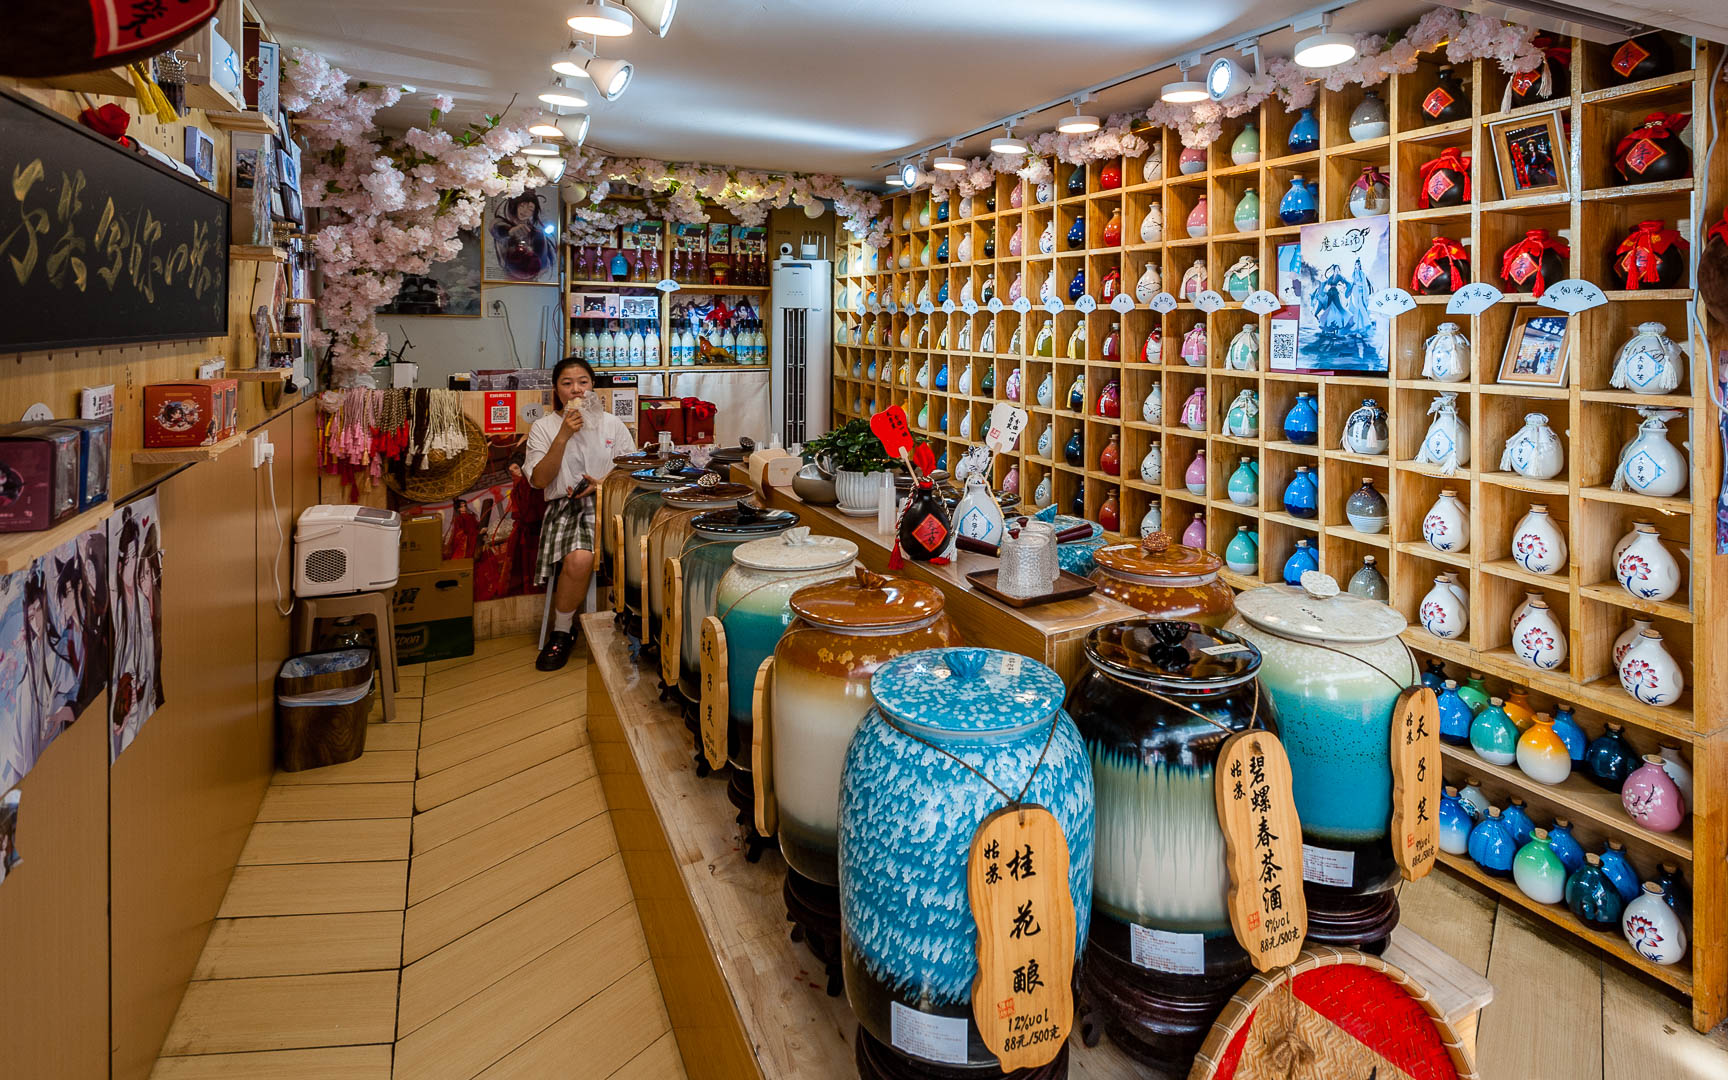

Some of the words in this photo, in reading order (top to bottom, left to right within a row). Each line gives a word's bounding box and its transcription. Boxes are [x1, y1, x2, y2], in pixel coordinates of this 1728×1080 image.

[924, 520, 940, 547] 天子笑
[1406, 711, 1415, 745] 姑苏
[1230, 759, 1247, 801] 姑苏
[1415, 714, 1429, 824] 天子笑
[1248, 755, 1283, 915] 碧螺春茶酒
[983, 839, 1003, 885] 姑苏
[1006, 844, 1044, 995] 桂花酿
[1003, 1024, 1061, 1053] 88元/500克
